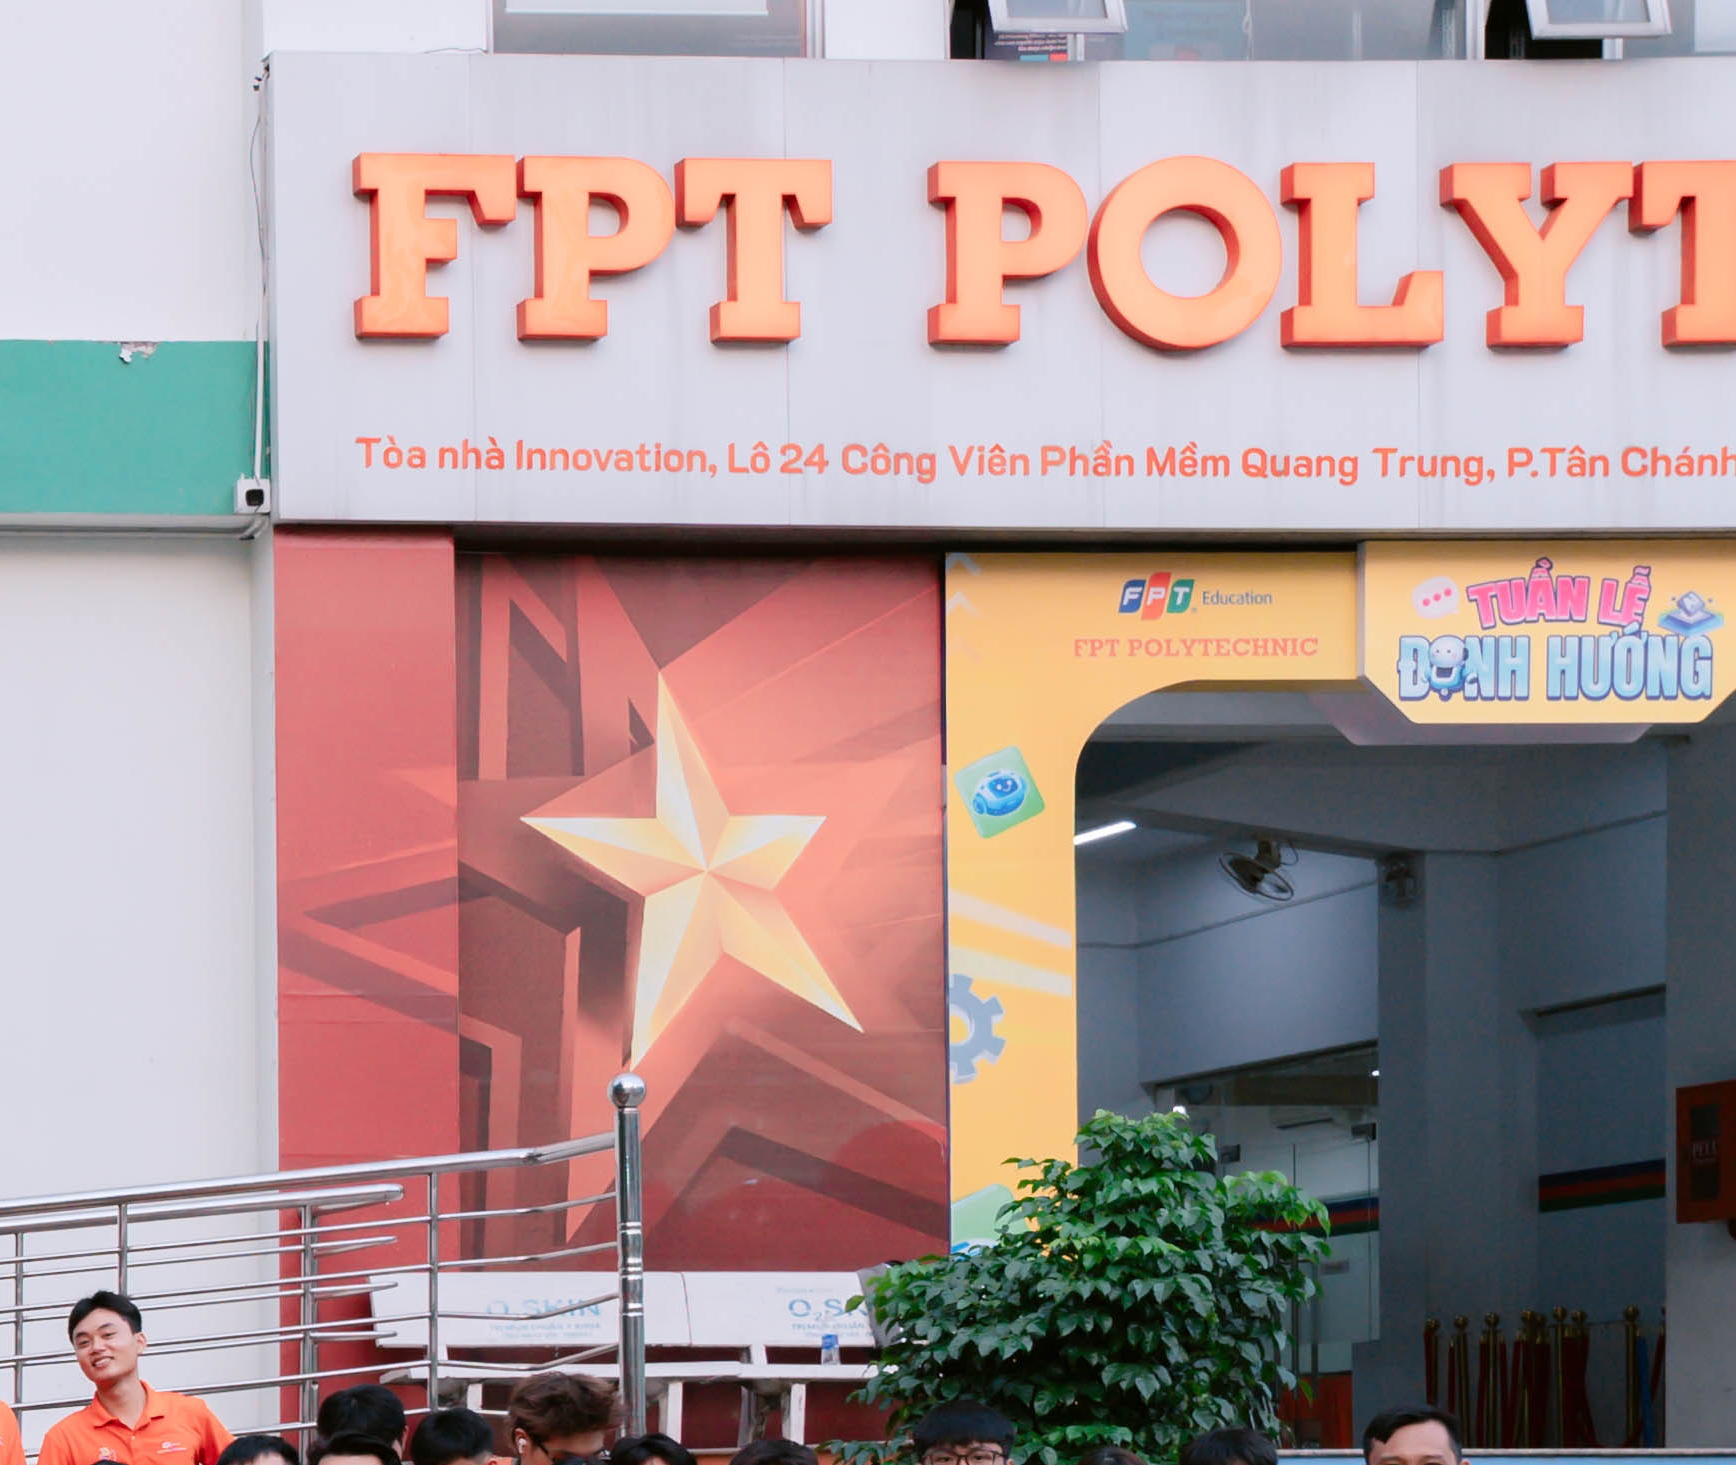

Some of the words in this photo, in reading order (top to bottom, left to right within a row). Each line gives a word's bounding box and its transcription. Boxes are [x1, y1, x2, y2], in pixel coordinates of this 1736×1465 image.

[352, 152, 832, 342] FPT
[355, 435, 426, 470] Tòa
[437, 435, 505, 471] nhà
[515, 439, 717, 479] Innovation,
[727, 441, 771, 475] Lô
[779, 443, 829, 475] 24
[841, 441, 937, 484] Công
[949, 443, 1030, 477] Viên
[1040, 439, 1134, 478] Phần
[1146, 440, 1230, 478] Mềm
[1241, 446, 1359, 486] Quang
[1373, 446, 1496, 486] Trung,
[1507, 446, 1610, 479] P.Tân
[1202, 591, 1273, 606] Education
[1466, 557, 1591, 630] TUẦN
[1074, 638, 1120, 657] FPT
[1127, 637, 1319, 657] POLYTECHNIC
[1547, 622, 1713, 700] HƯỚNG
